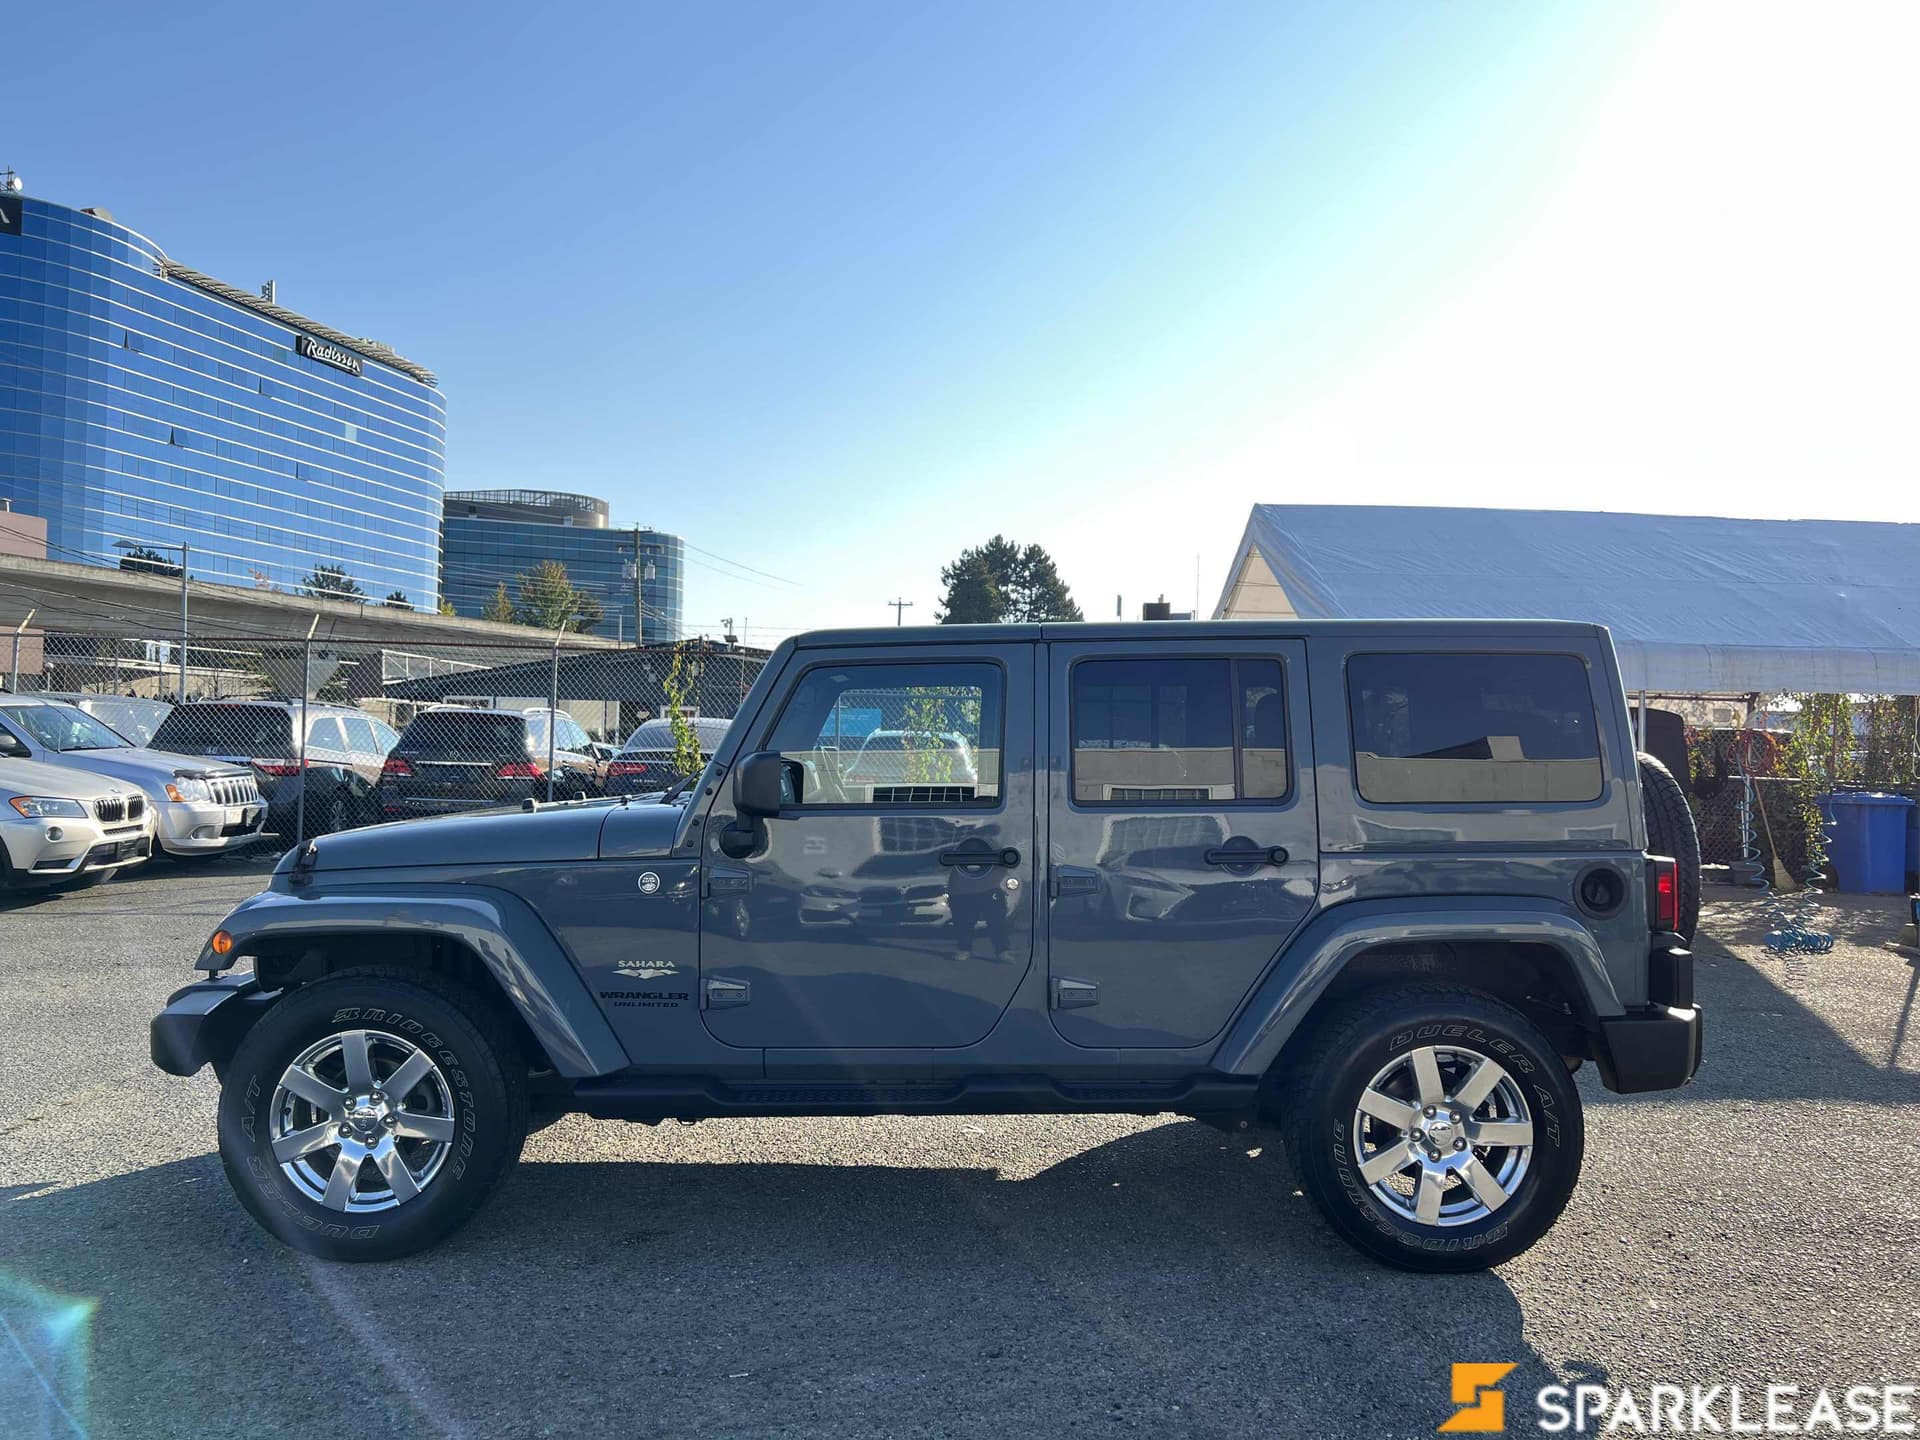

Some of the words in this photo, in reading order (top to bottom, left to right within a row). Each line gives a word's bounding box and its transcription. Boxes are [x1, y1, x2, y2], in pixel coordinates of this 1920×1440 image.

[306, 336, 361, 373] Radisson
[600, 991, 689, 1000] WRANGLER
[617, 959, 676, 968] SAHARA
[331, 1007, 477, 1181] BRIDGESTONE
[1390, 1024, 1536, 1074] DUELER
[1533, 1084, 1561, 1148] A/T
[246, 1155, 380, 1240] DUELER
[1332, 1118, 1510, 1252] BRIDGESTONE
